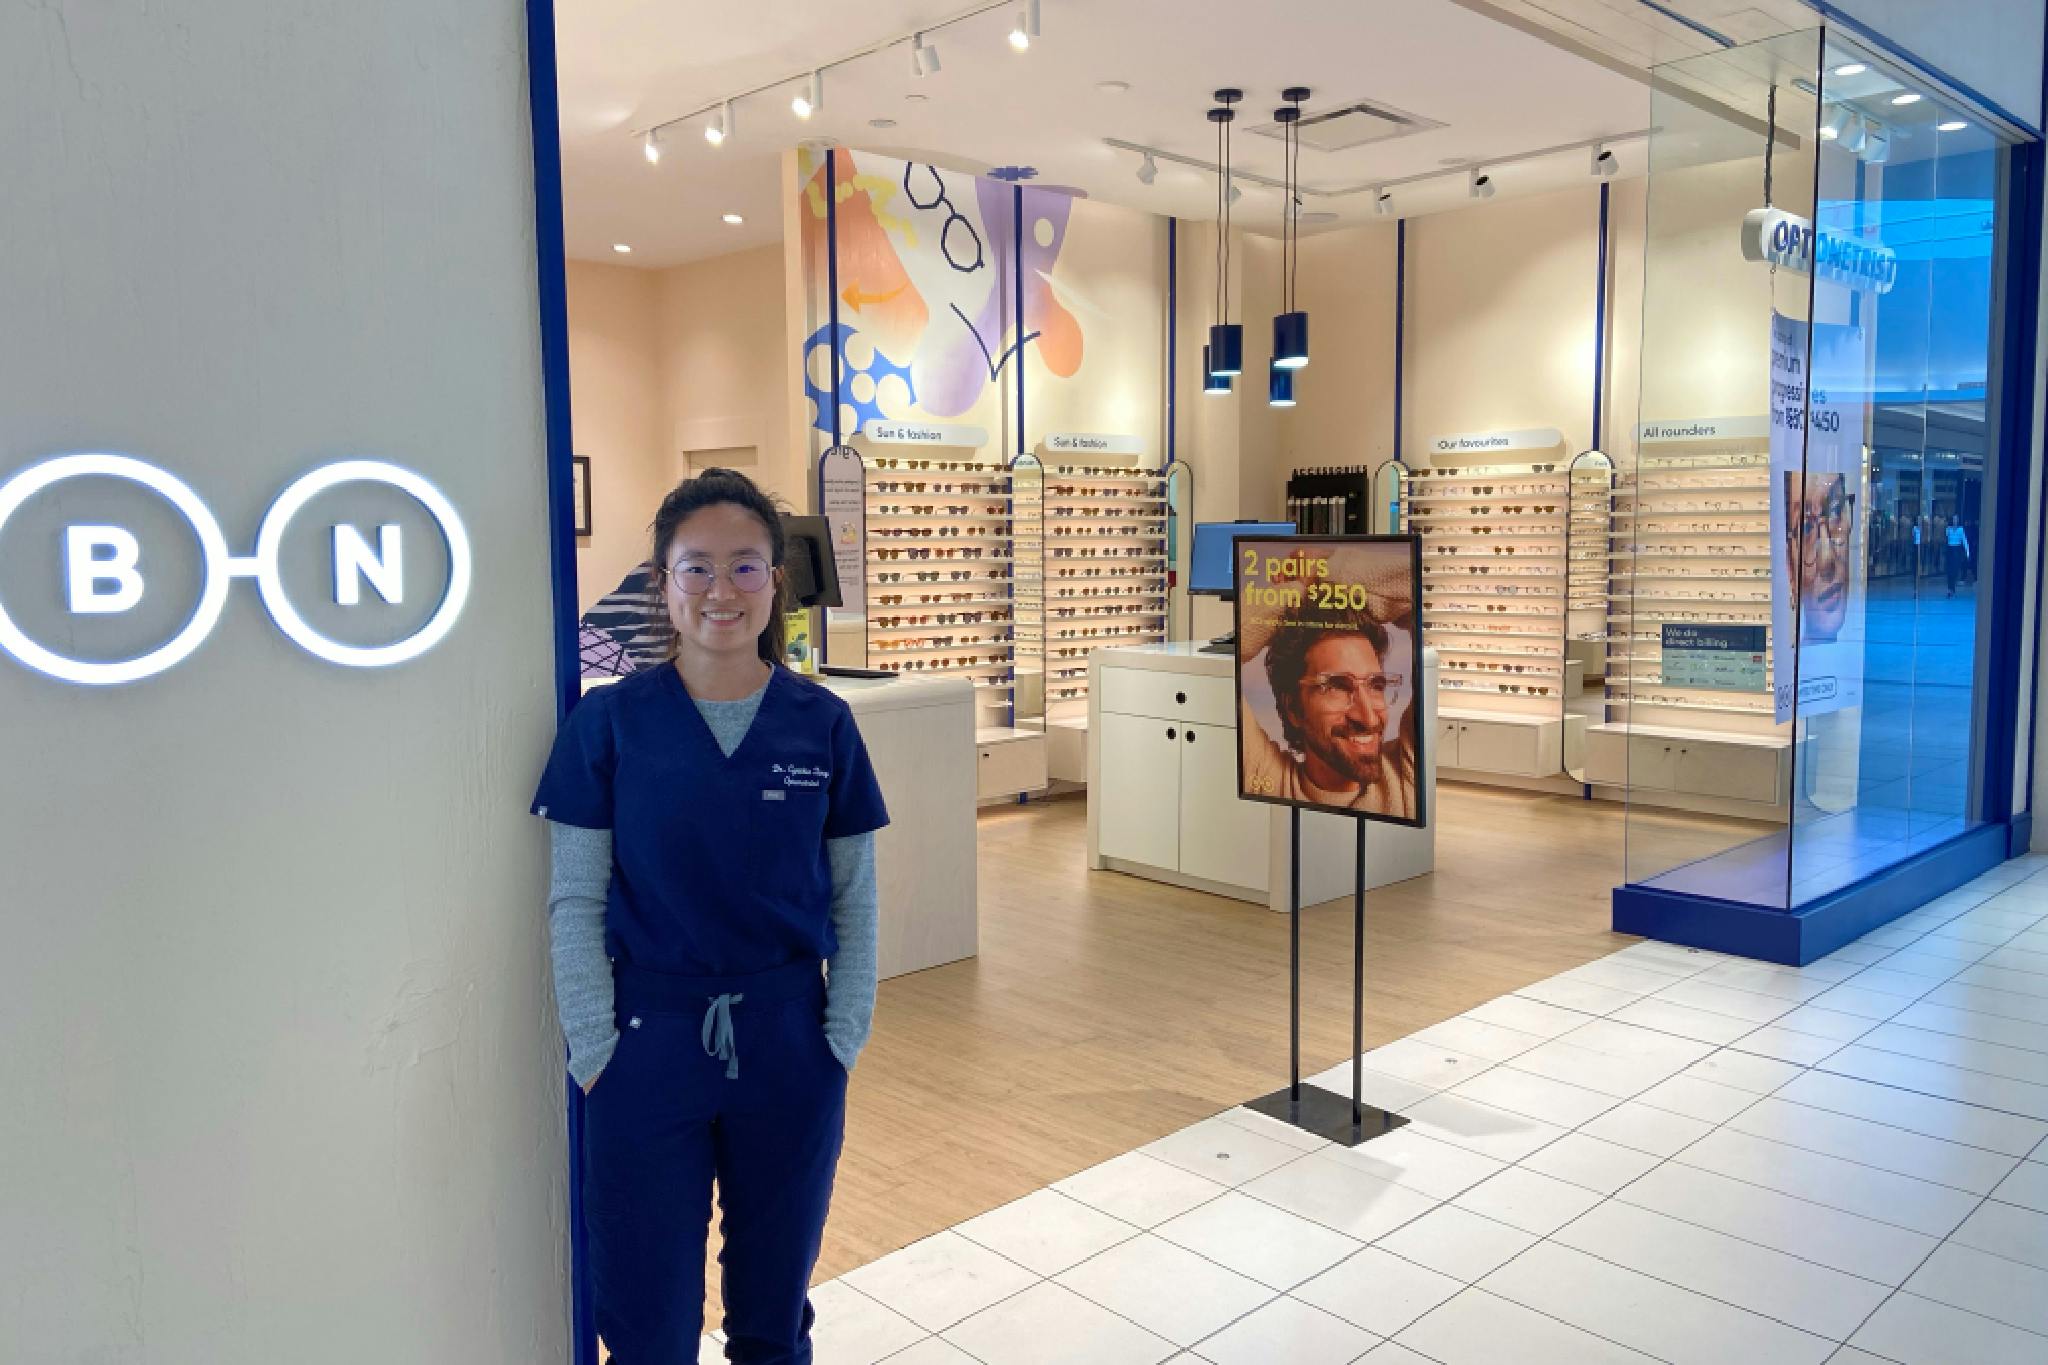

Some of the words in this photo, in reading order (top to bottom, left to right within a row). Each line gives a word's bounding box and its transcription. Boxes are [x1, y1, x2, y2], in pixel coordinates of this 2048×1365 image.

[876, 426, 895, 438] Sun
[1643, 427, 1659, 438] All
[1661, 424, 1716, 438] rounders
[66, 524, 145, 614] B
[330, 524, 403, 606] N
[1244, 549, 1259, 577] 2
[1265, 551, 1330, 583] pairs
[1244, 580, 1302, 608] from
[1307, 583, 1367, 611] $250
